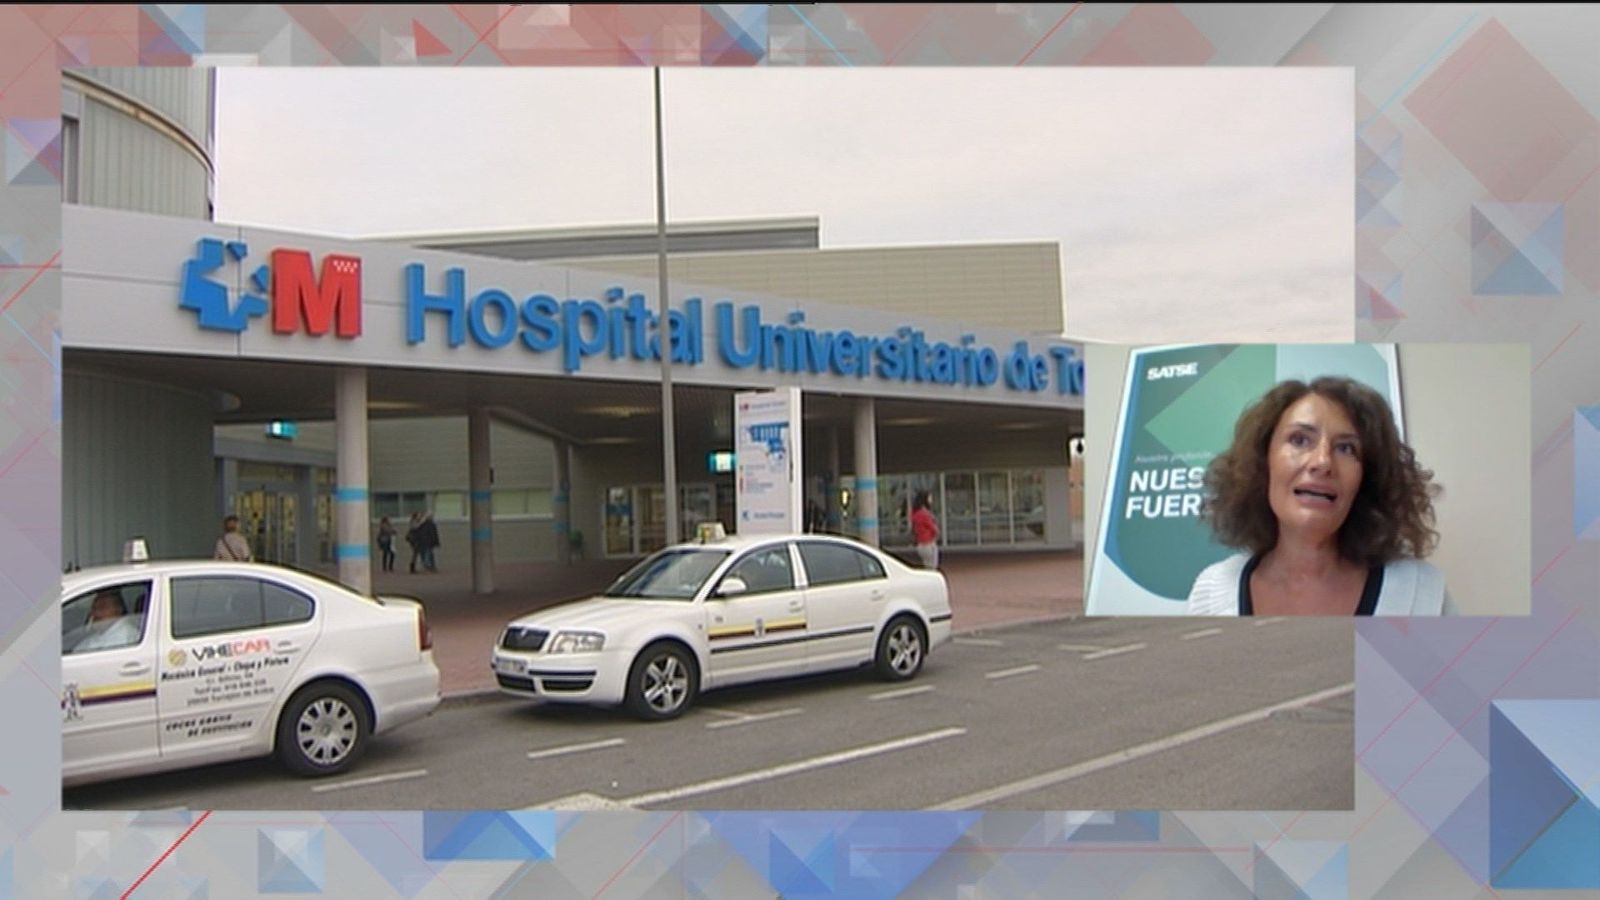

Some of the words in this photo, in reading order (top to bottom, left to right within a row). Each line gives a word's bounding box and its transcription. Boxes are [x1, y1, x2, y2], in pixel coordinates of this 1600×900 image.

[271, 248, 362, 339] M
[405, 262, 704, 373] Hospital
[715, 301, 999, 389] Universitario
[1004, 340, 1049, 392] de
[1147, 362, 1198, 380] SATSE
